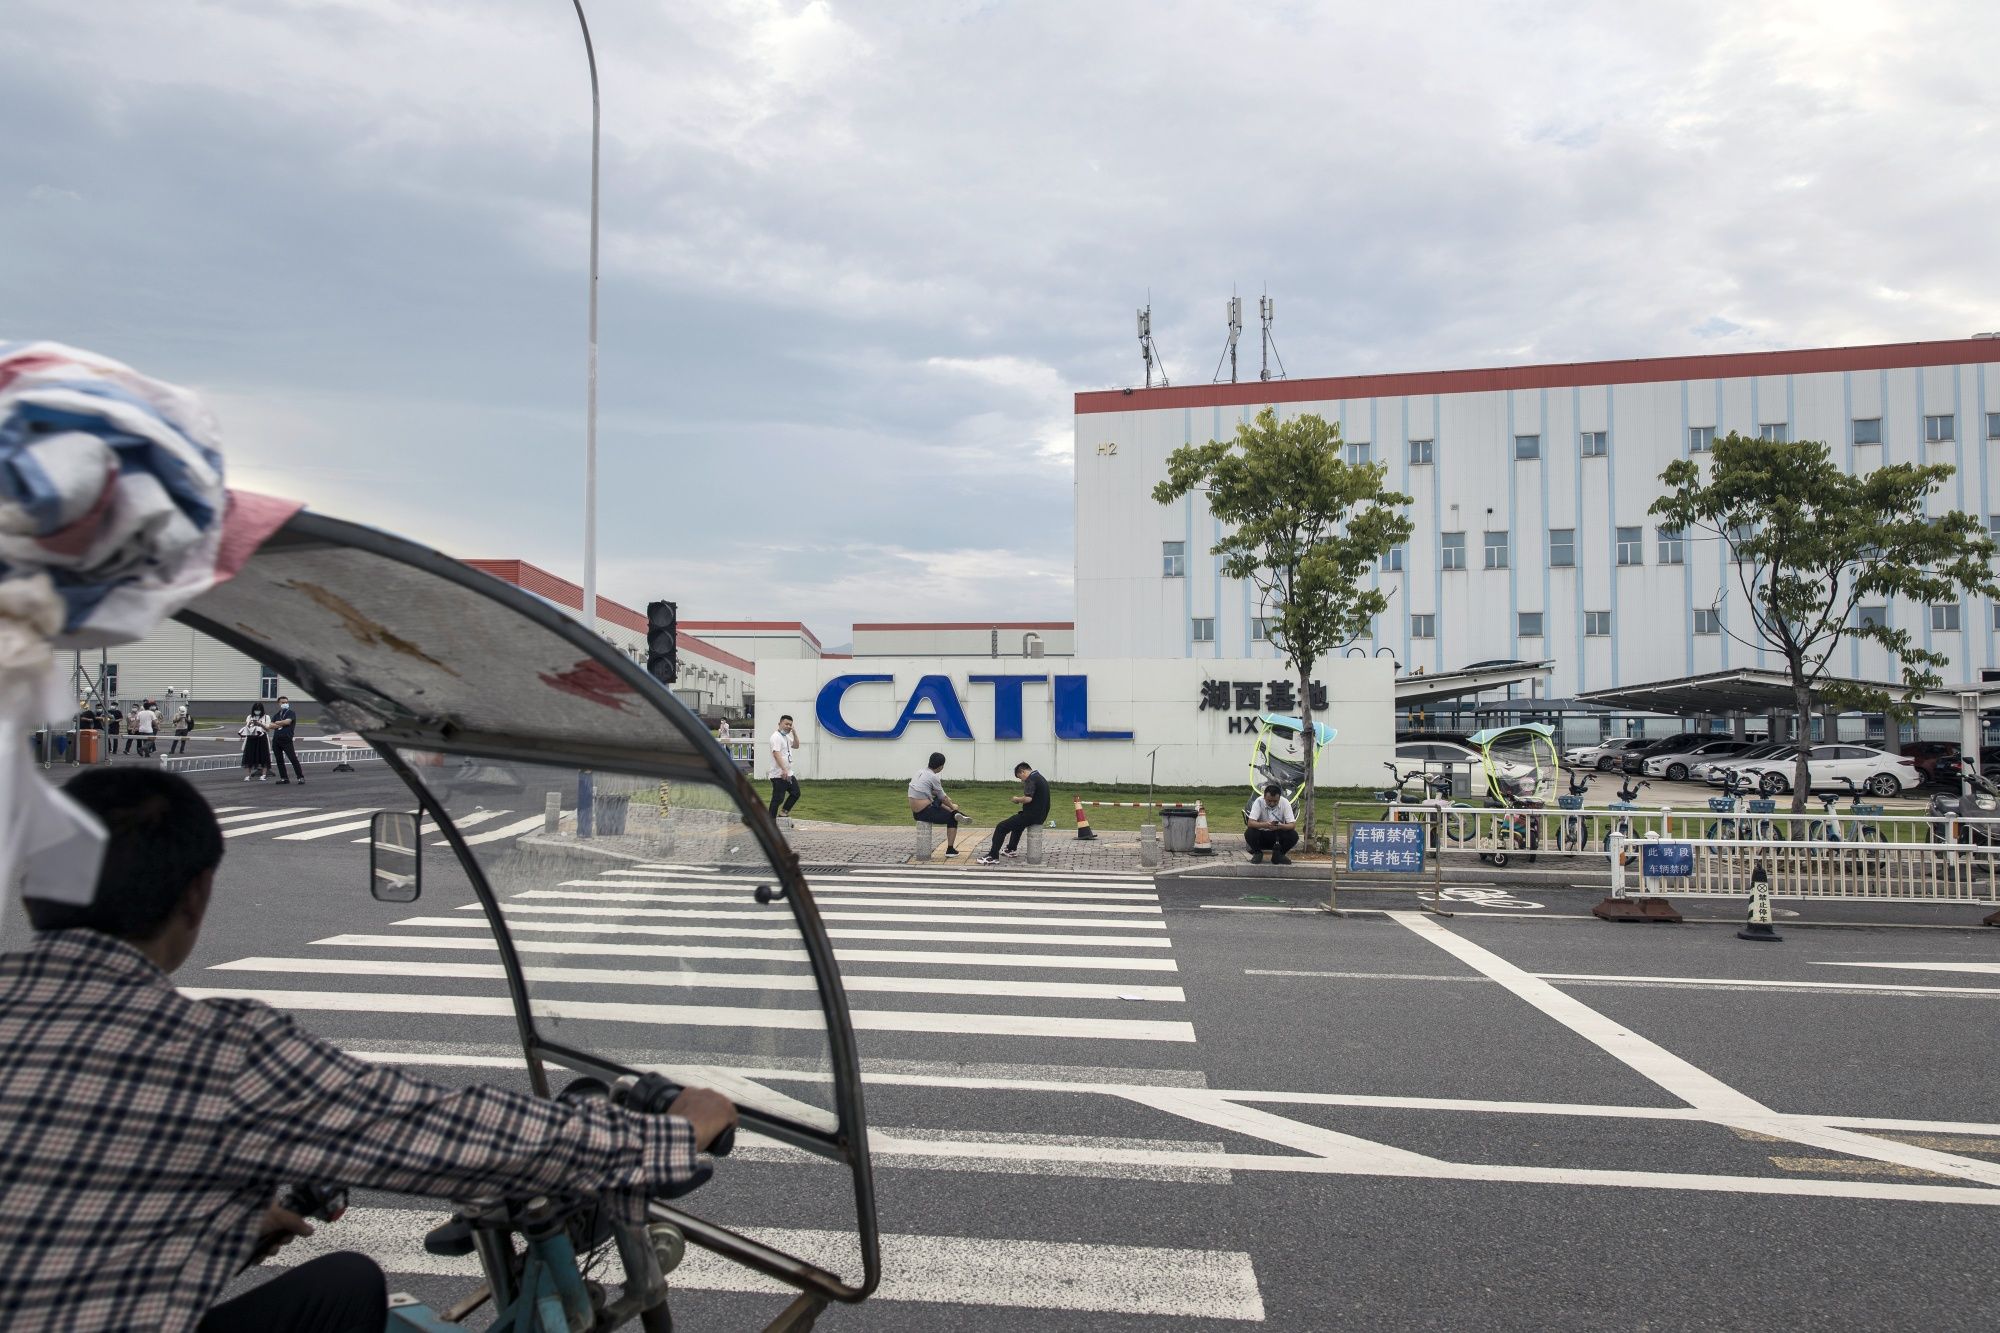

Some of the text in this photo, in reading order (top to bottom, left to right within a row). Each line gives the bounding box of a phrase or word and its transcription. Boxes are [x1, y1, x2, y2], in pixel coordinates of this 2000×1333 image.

[1097, 442, 1117, 456] H2
[815, 673, 1135, 740] CATL
[1355, 827, 1417, 843] 车辆禁停
[1354, 850, 1416, 866] 违者拖车
[1648, 847, 1689, 857] 此路段
[1649, 864, 1689, 874] 车辆禁停
[1758, 894, 1768, 923] 禁止停车
